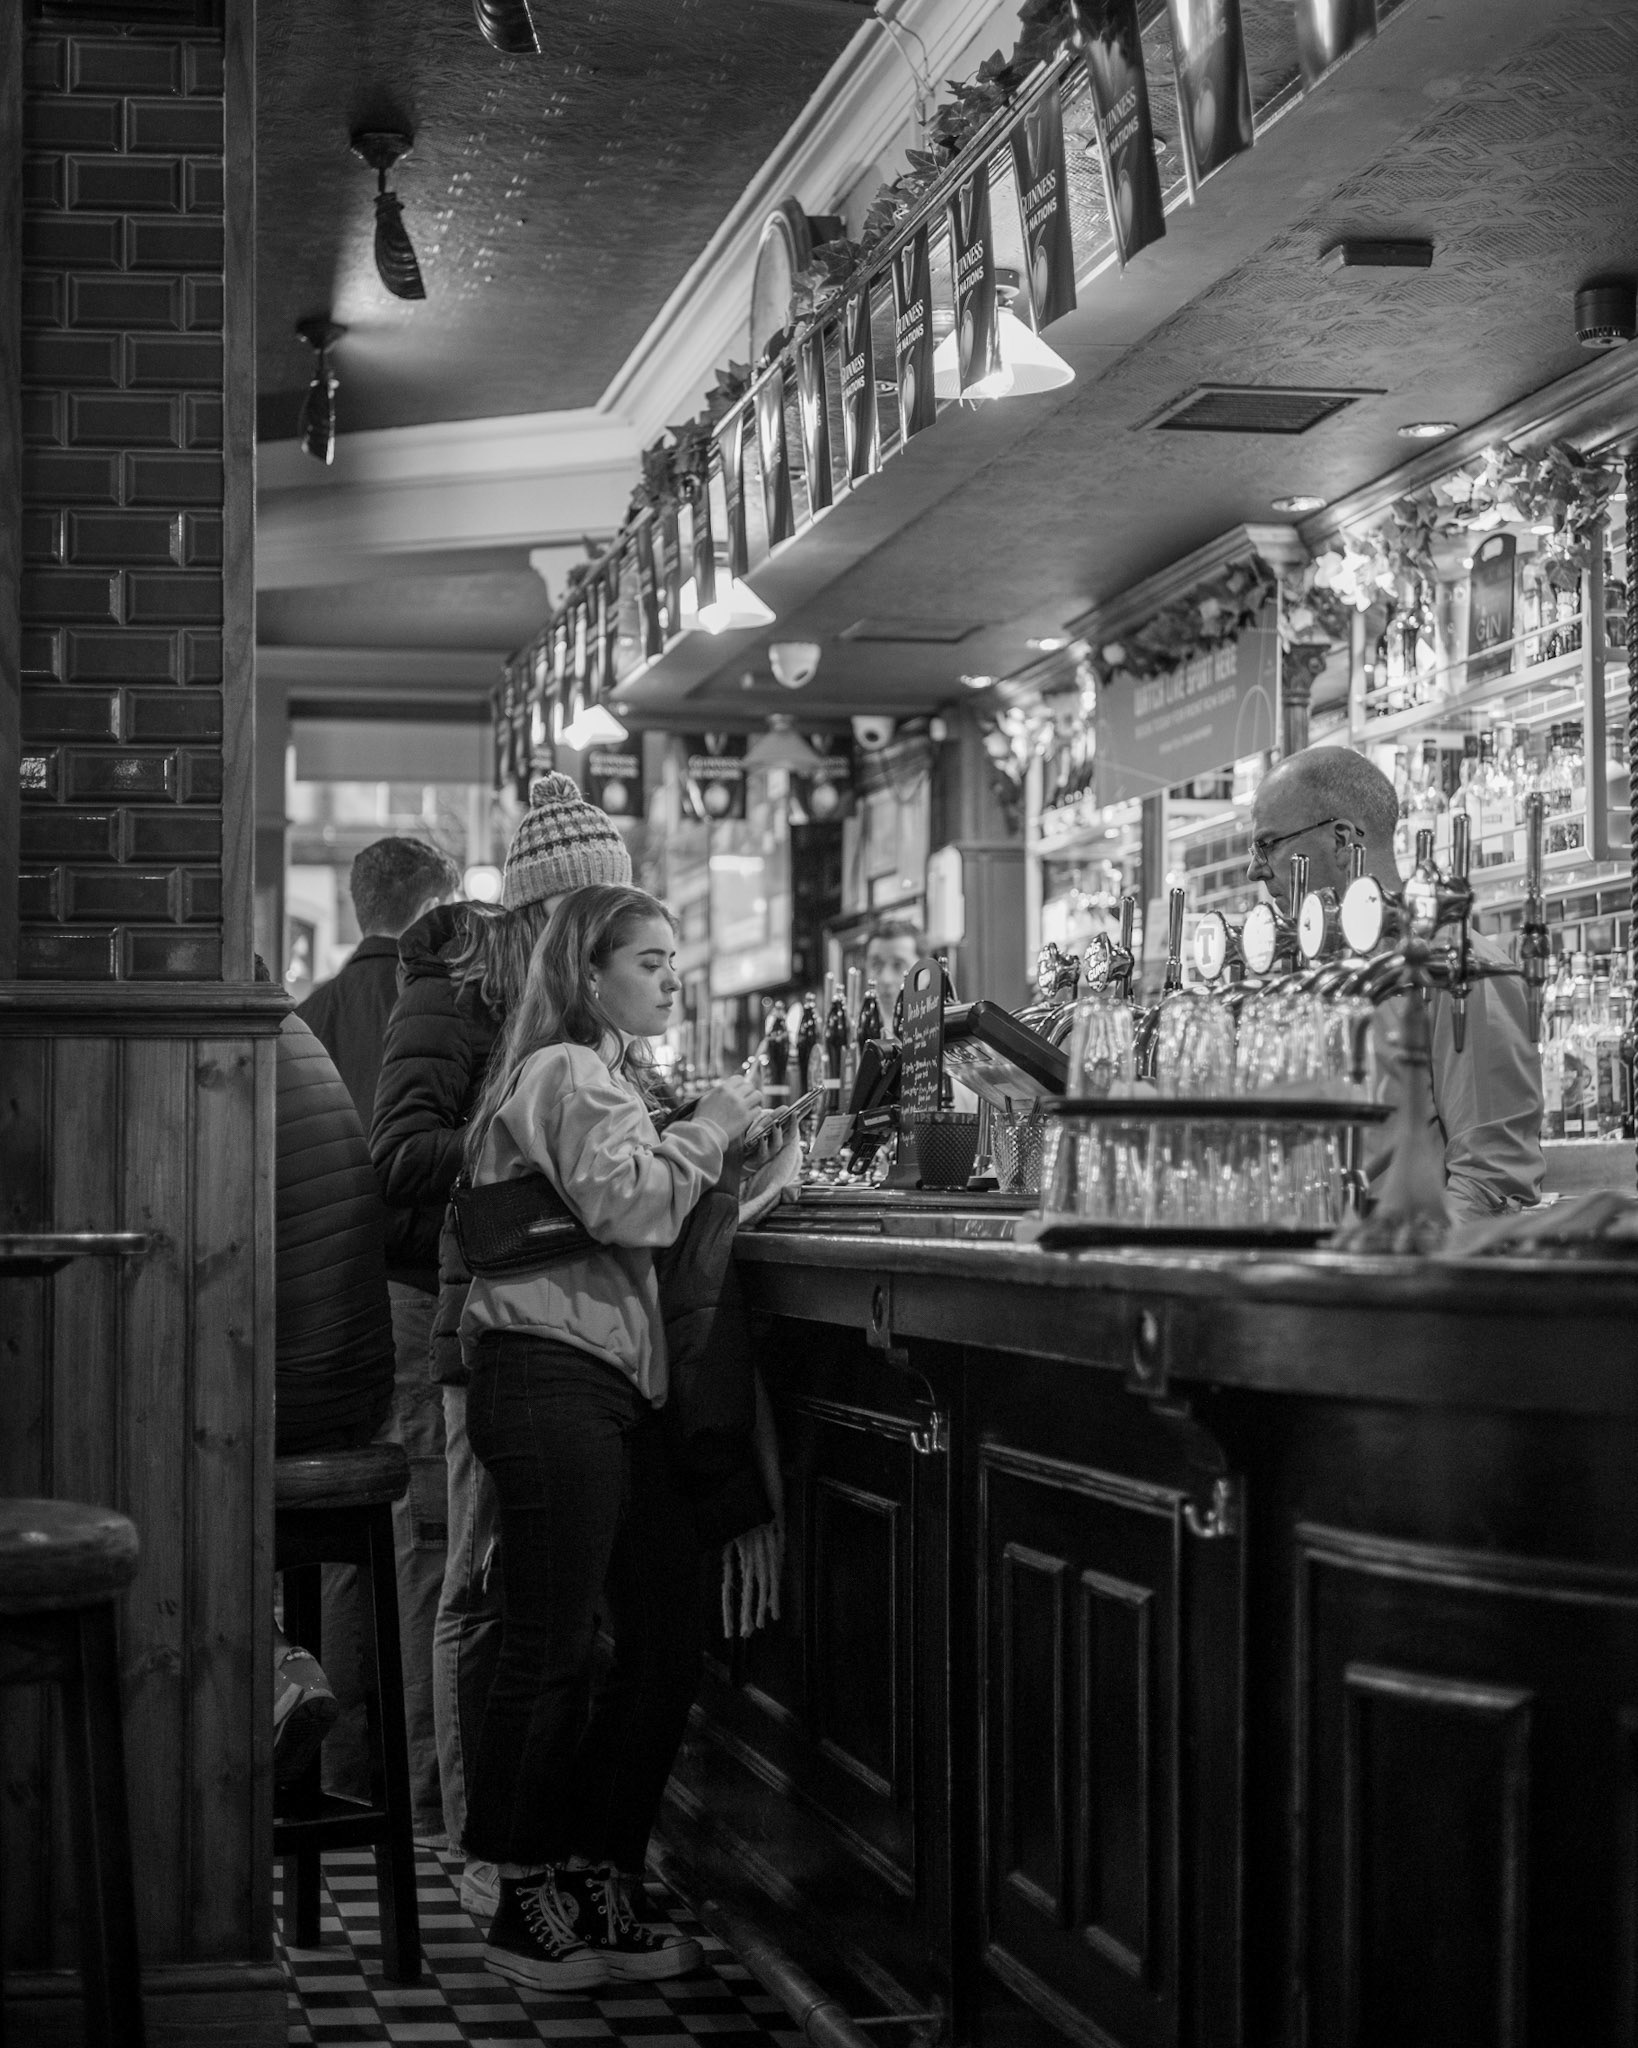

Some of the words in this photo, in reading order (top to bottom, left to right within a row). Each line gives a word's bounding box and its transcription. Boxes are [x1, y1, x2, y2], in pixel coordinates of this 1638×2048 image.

[1110, 115, 1139, 156] NATIONS
[1020, 168, 1056, 217] GUINNESS
[1029, 196, 1057, 232] NATIONS
[959, 265, 984, 296] NATIONS
[896, 298, 923, 338] GUINNESS
[902, 323, 924, 350] NATIONS
[1475, 612, 1502, 643] GIN
